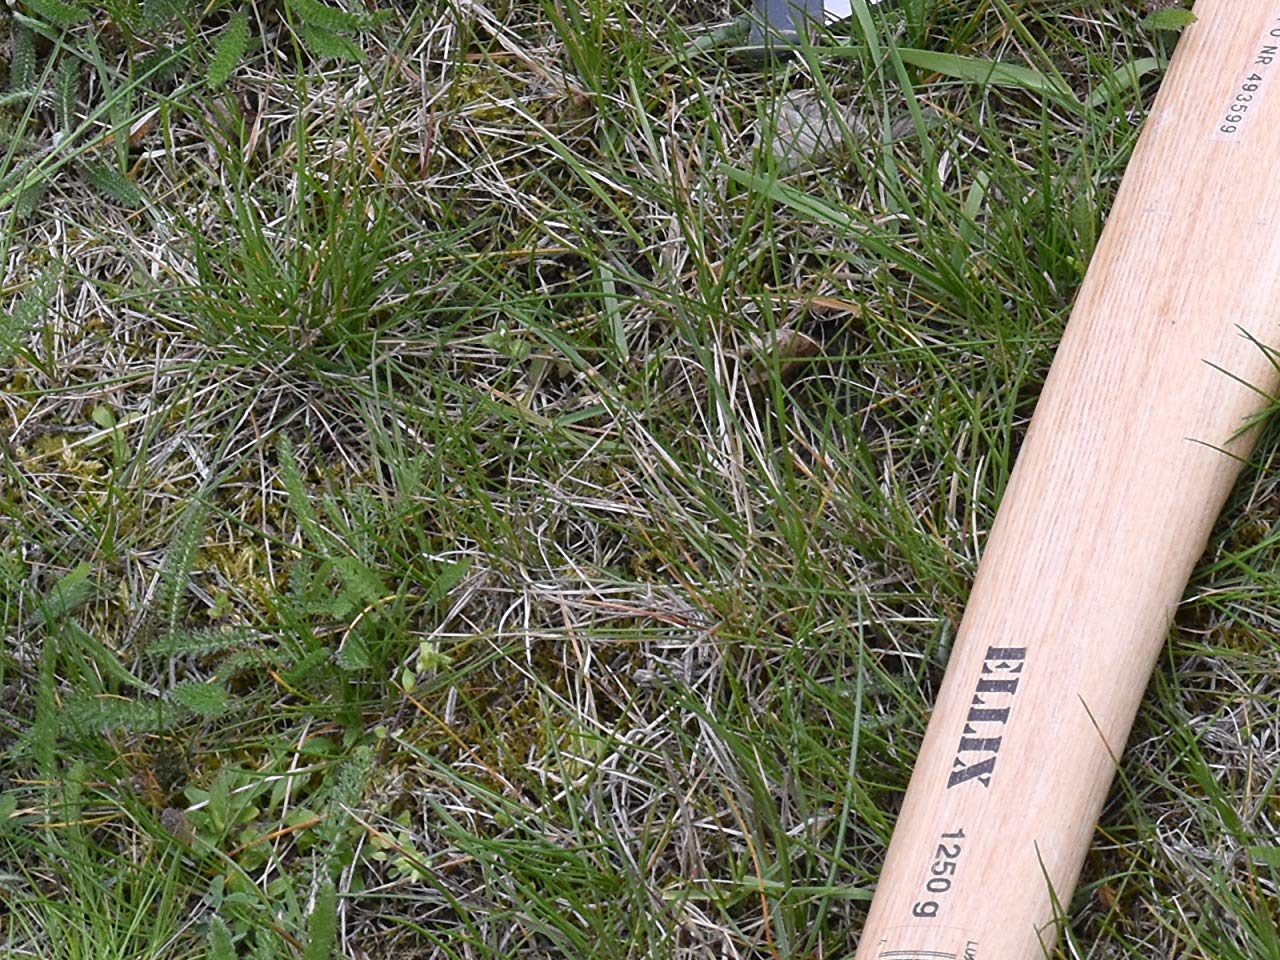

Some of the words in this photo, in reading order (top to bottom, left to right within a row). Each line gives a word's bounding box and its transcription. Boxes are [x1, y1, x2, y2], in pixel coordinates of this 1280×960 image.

[1254, 45, 1279, 65] NR
[1220, 73, 1263, 134] 493599
[947, 646, 1028, 789] ELLIX
[926, 828, 966, 893] 1250
[912, 901, 940, 918] g
